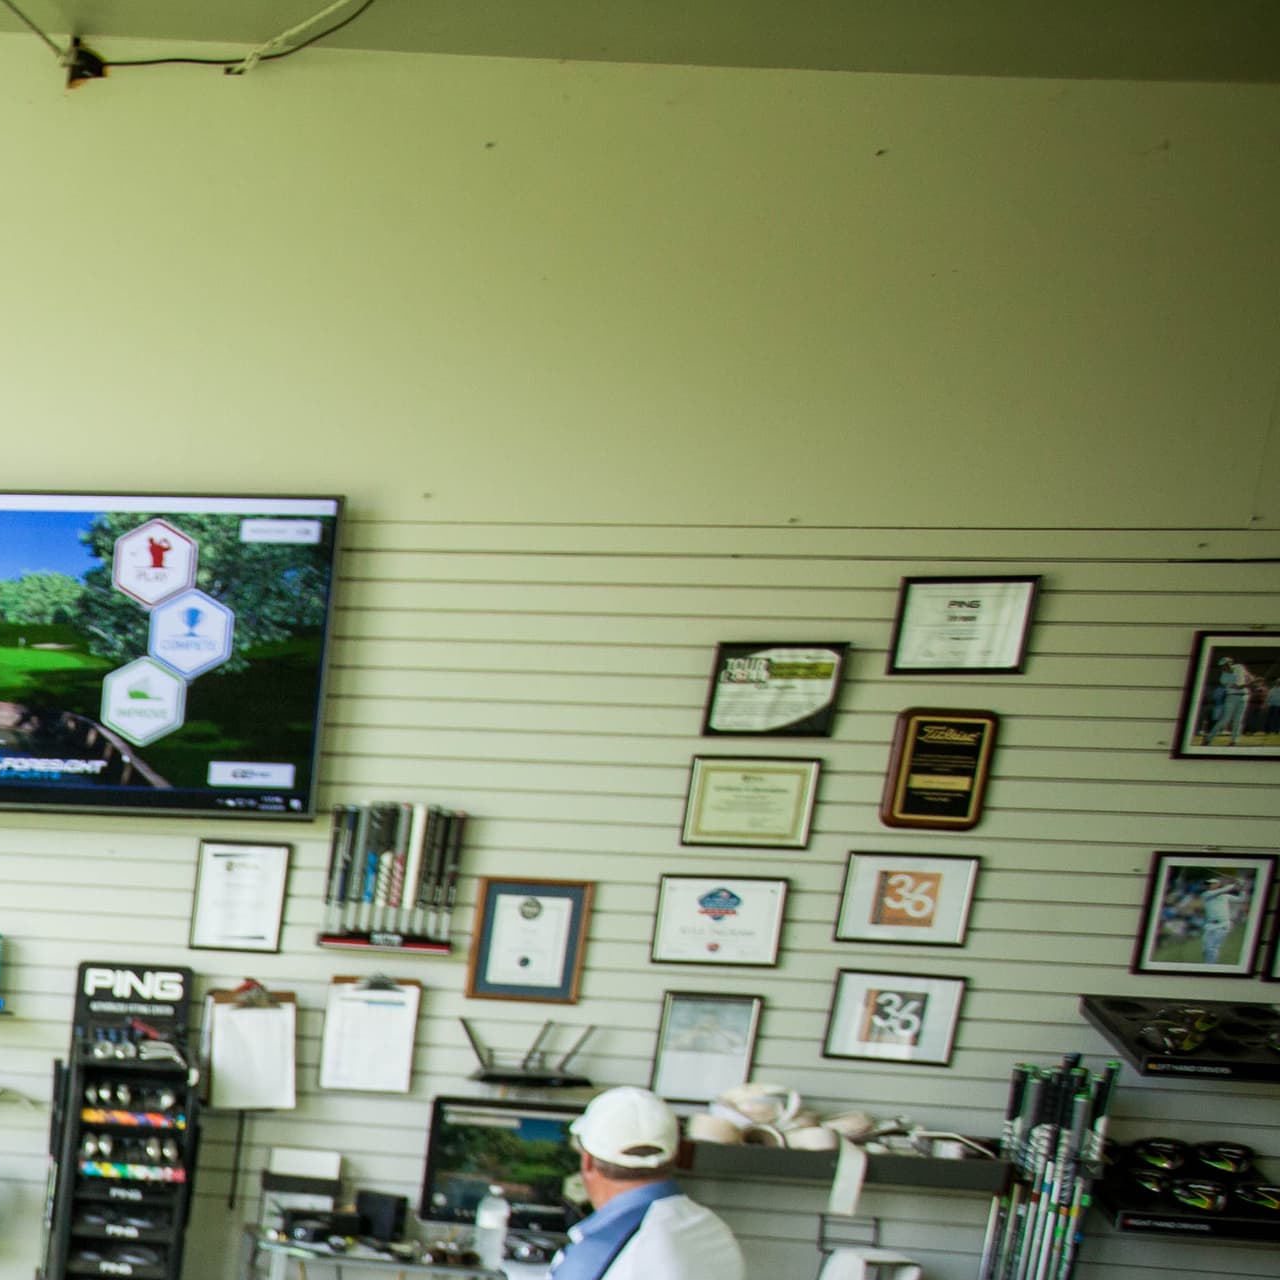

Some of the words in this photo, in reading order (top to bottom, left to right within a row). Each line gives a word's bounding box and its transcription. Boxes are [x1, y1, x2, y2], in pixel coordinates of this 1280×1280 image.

[947, 600, 982, 609] PING
[0, 756, 108, 775] FORESIGHT
[883, 874, 934, 918] 36
[84, 968, 184, 1001] PING
[872, 992, 921, 1037] 36
[109, 1187, 142, 1200] PING
[106, 1224, 139, 1238] PING
[99, 1261, 133, 1275] PING
